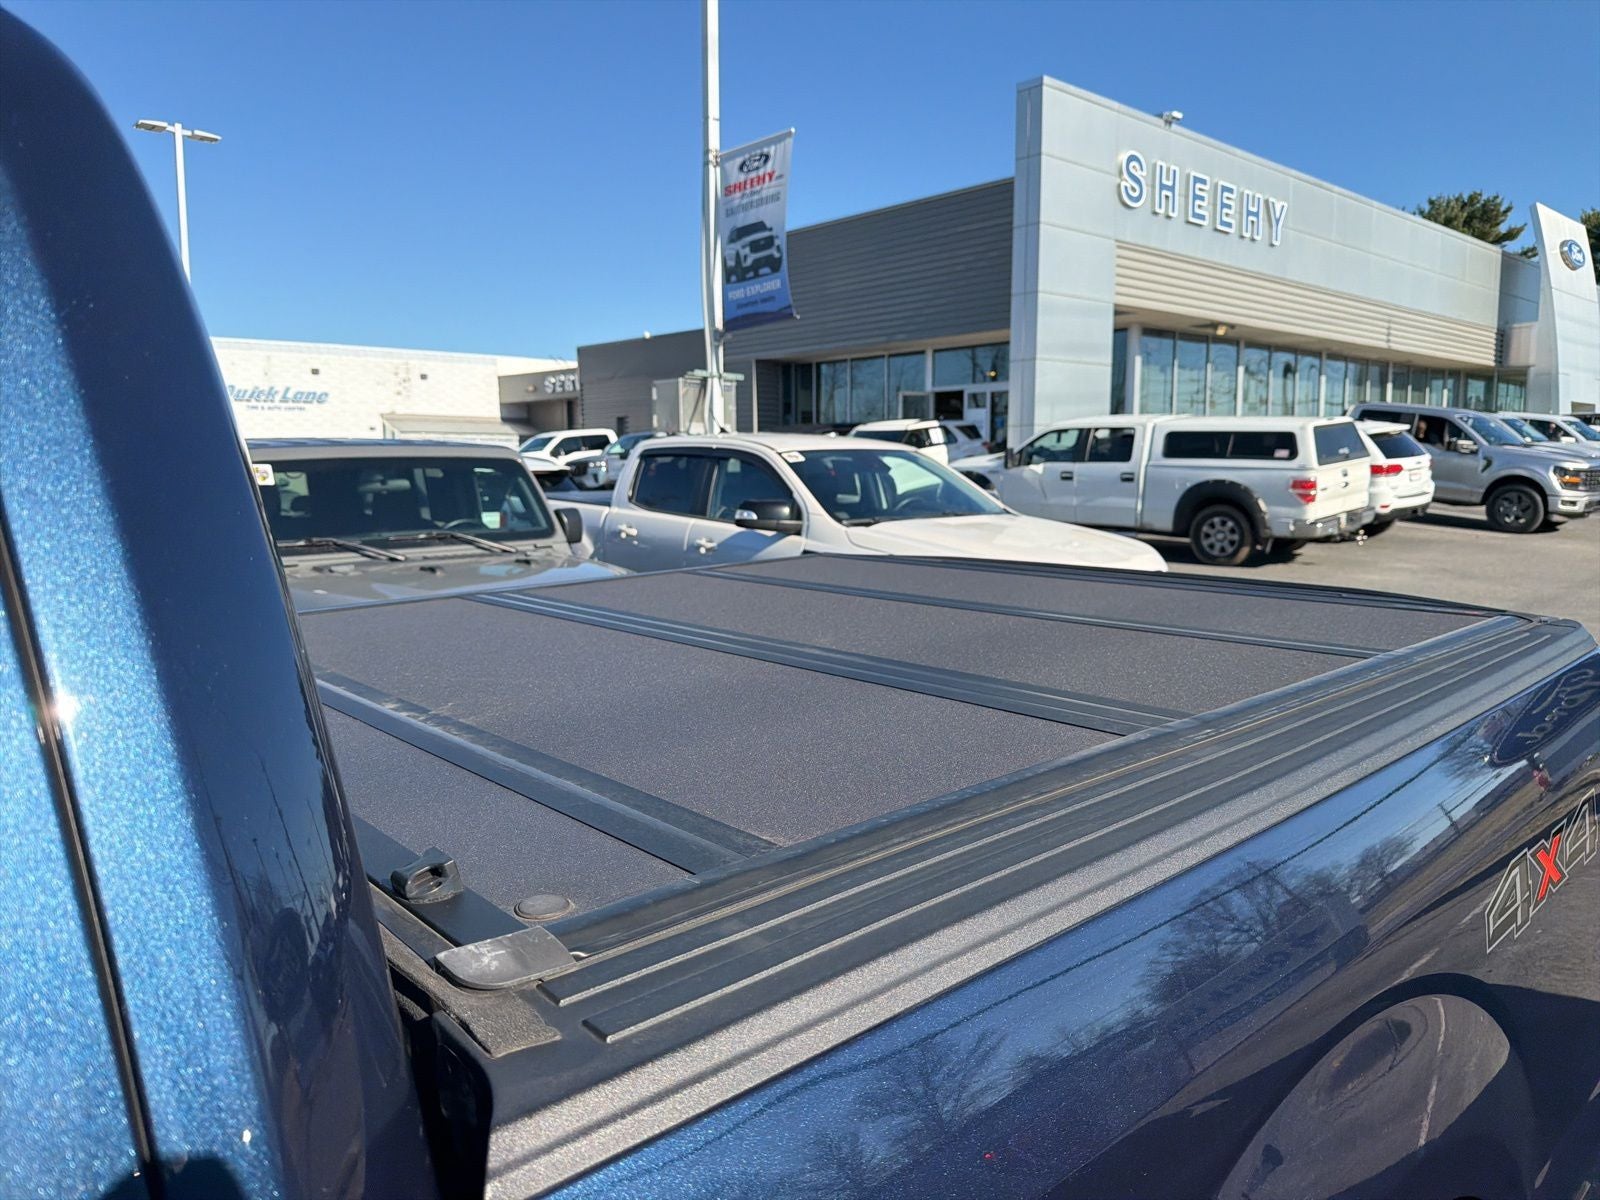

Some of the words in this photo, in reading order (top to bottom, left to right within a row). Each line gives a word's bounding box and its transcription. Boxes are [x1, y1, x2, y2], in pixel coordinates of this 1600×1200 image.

[724, 169, 776, 197] SHEEHY
[1120, 149, 1288, 247] SHEEHY
[280, 386, 330, 404] Lane
